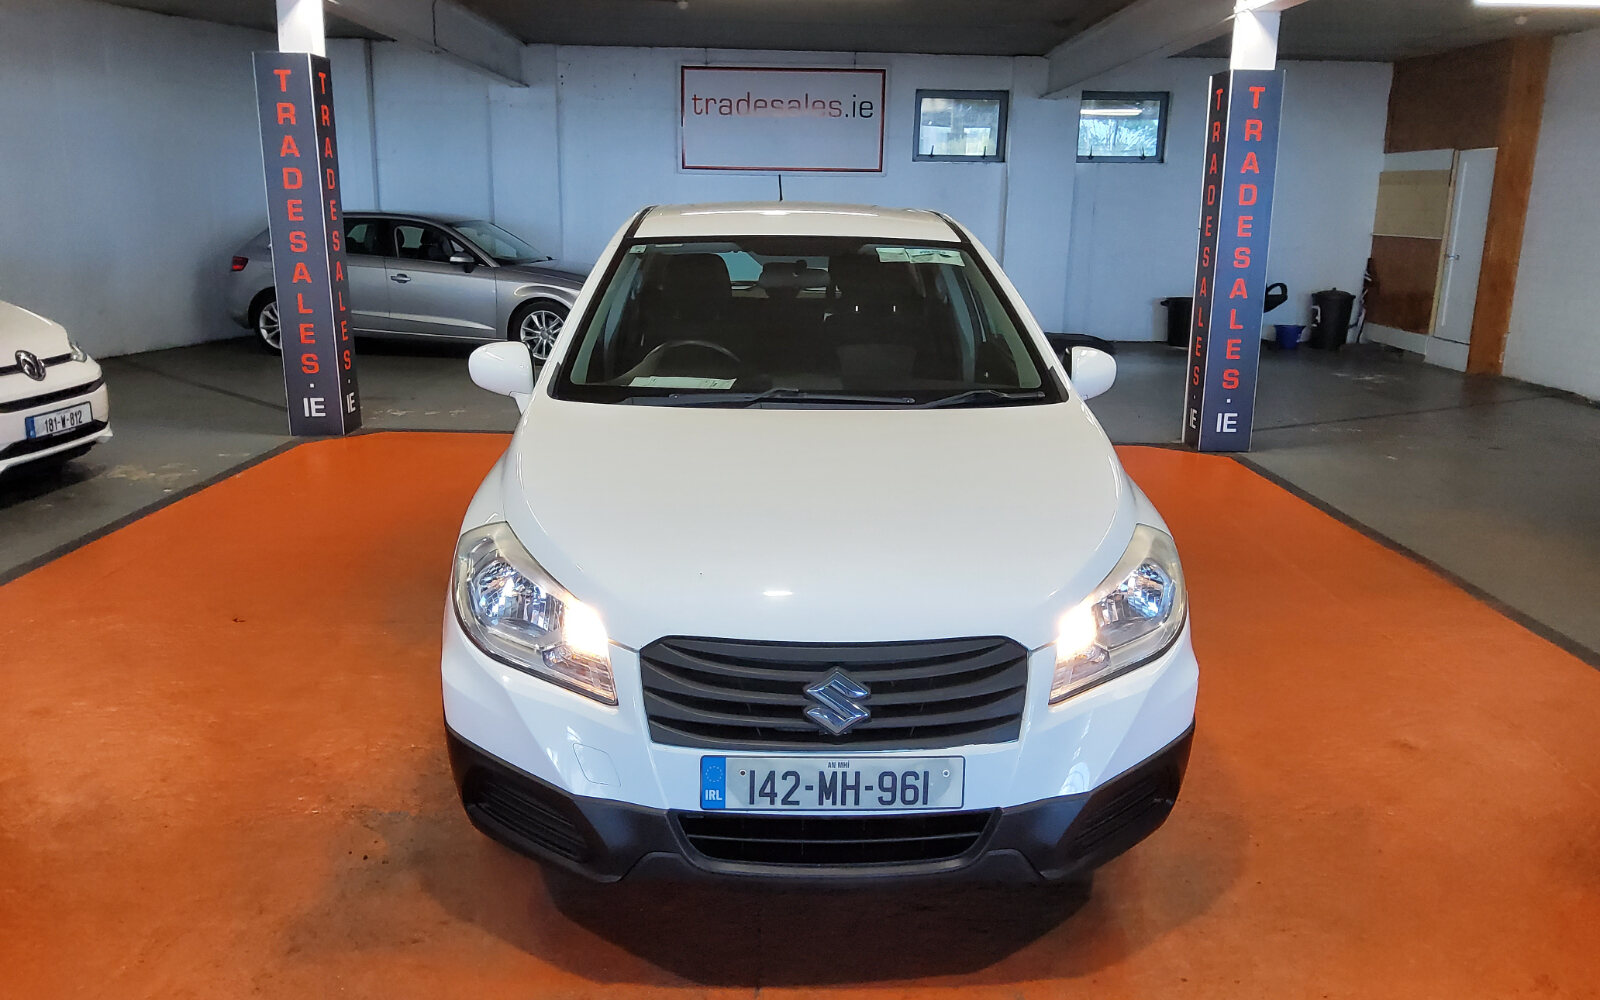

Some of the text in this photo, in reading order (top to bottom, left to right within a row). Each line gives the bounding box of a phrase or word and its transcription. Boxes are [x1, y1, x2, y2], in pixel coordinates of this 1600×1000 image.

[692, 91, 874, 118] tradesales.ie
[705, 790, 723, 801] IRL
[749, 770, 930, 806] 142-MH-961
